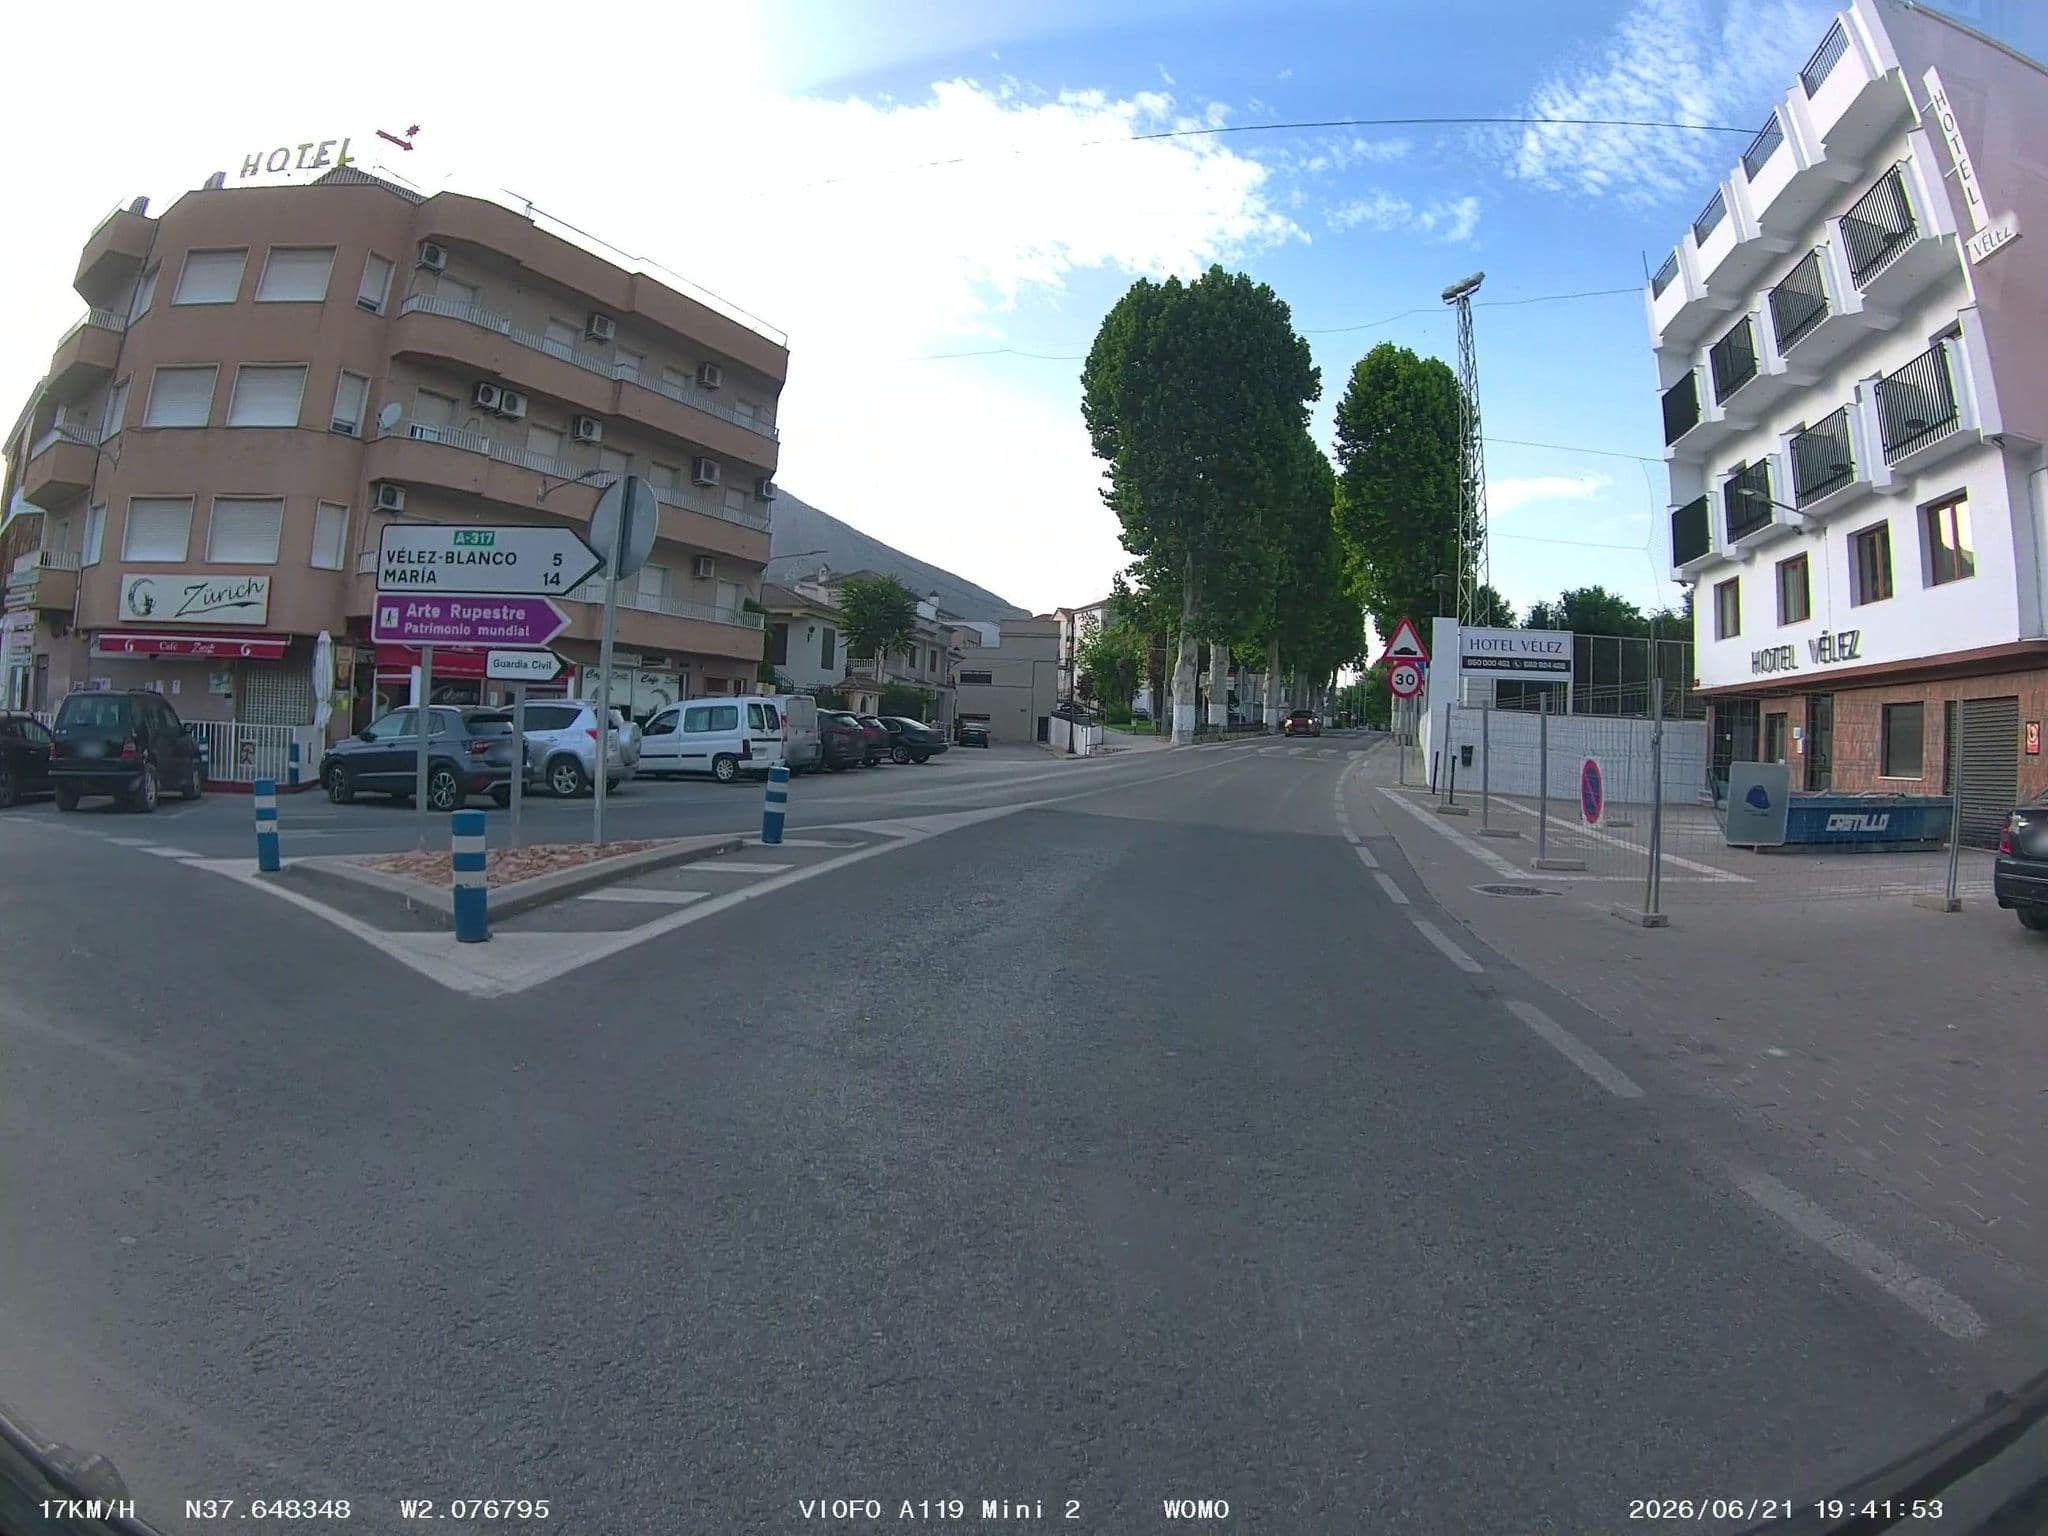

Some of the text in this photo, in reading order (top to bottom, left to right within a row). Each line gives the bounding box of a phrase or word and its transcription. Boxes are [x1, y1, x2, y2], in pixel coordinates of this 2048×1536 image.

[1933, 89, 1979, 206] HOTEL
[240, 138, 354, 179] HOTEL
[455, 531, 494, 545] A-317
[387, 547, 563, 567] VÉLEZ-BLANCO 5
[384, 568, 561, 586] MARÍA 14
[175, 576, 265, 618] Zürich
[406, 603, 526, 621] Arte Rupestre
[404, 622, 530, 637] Patrimonio mundial
[1470, 638, 1563, 654] HOTEL VÉLEZ
[1751, 630, 1861, 675] HOTEL VÉLEZ
[493, 658, 553, 670] Guardia Civil
[1394, 673, 1415, 686] 30
[1825, 813, 1890, 832] CASTILLO
